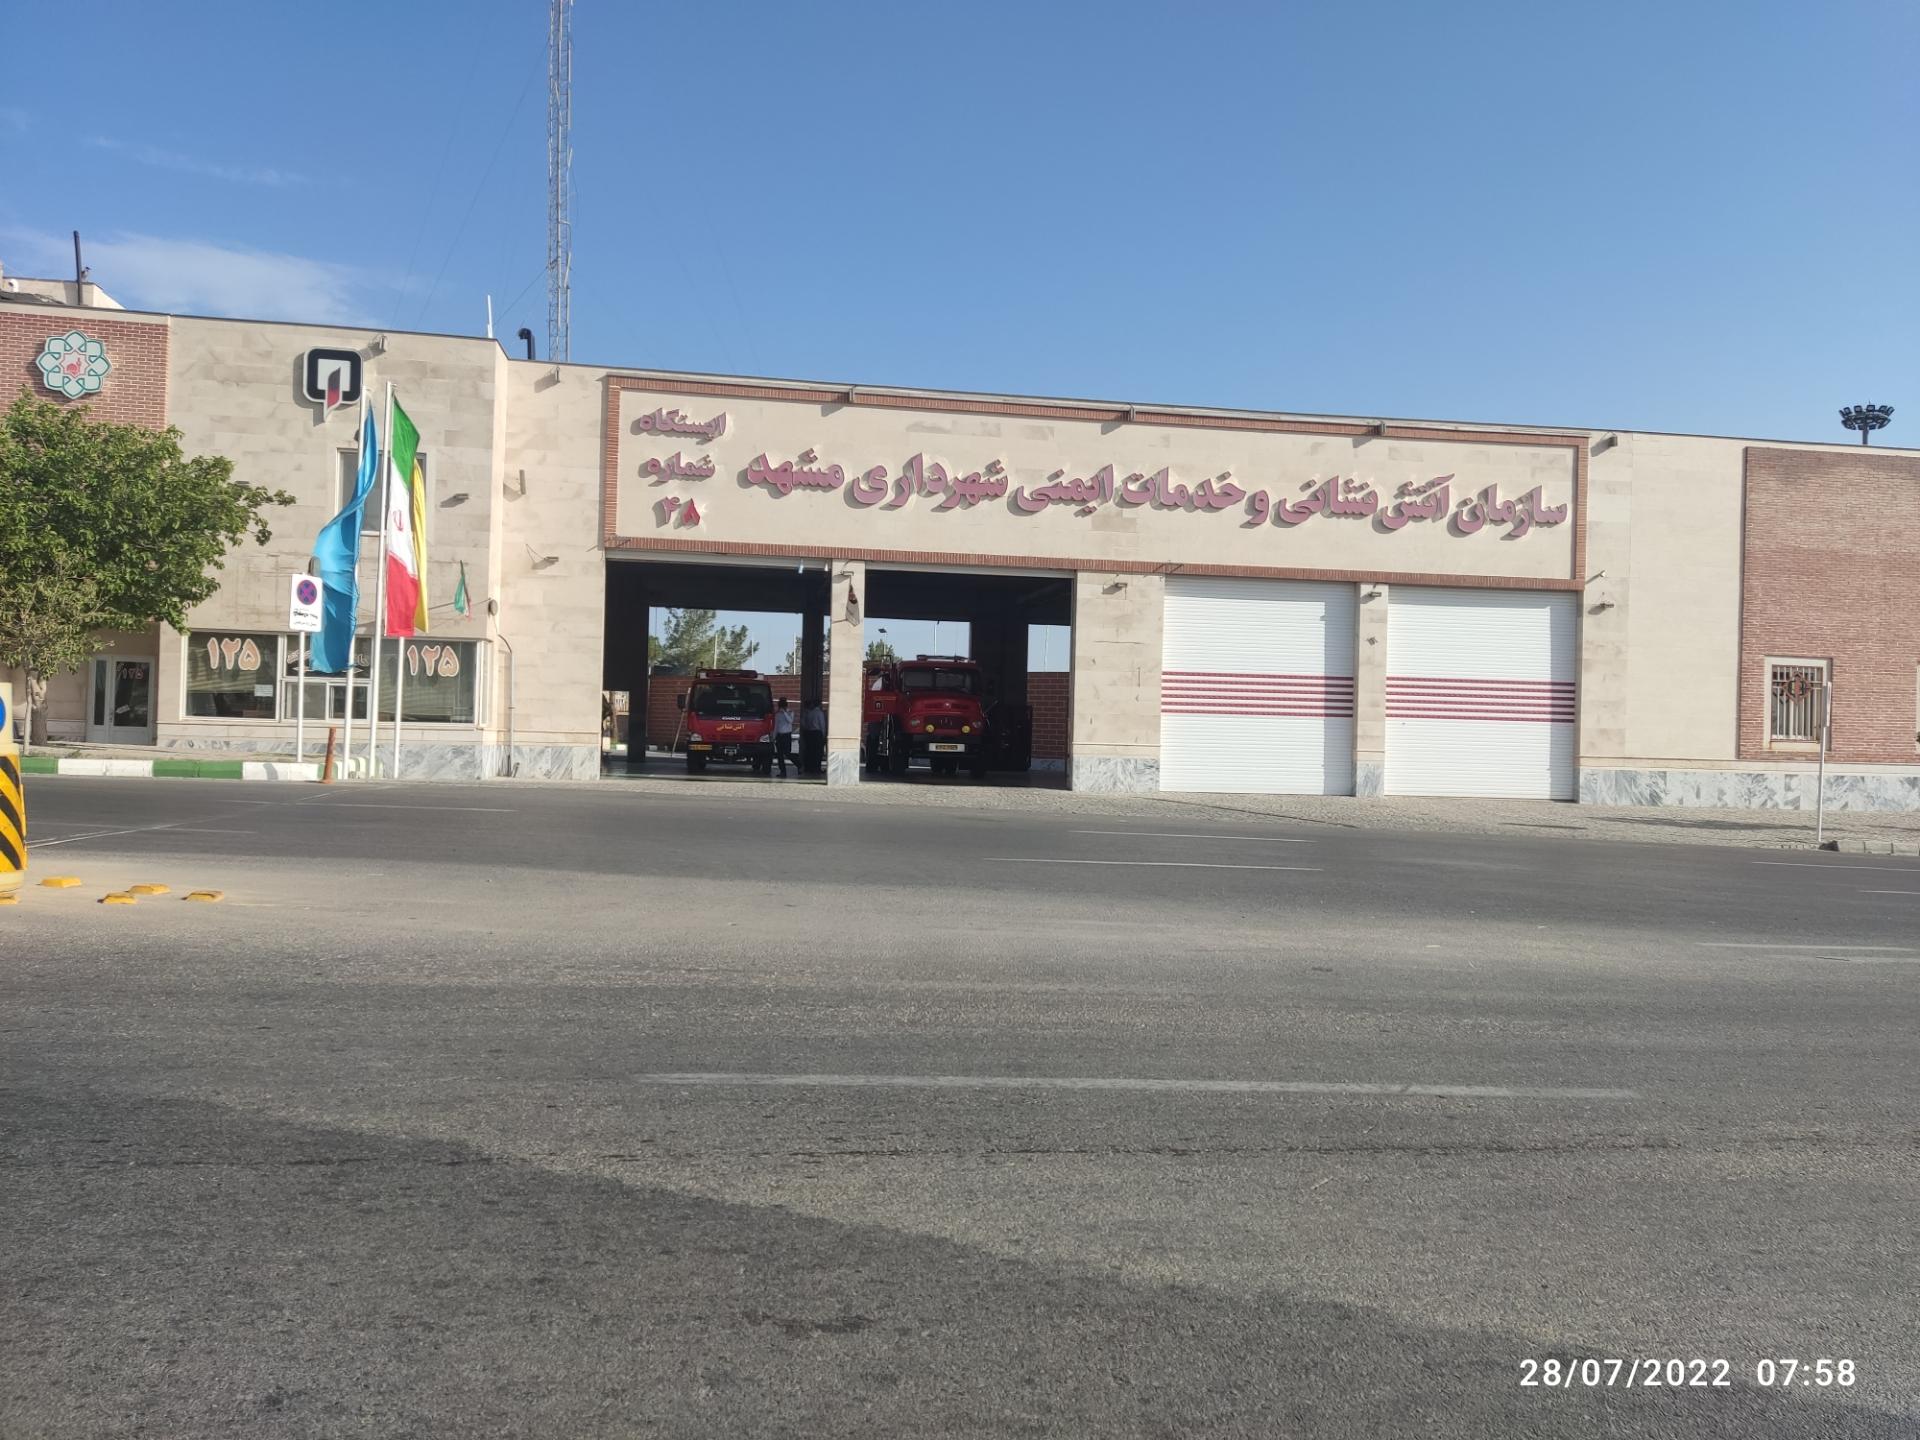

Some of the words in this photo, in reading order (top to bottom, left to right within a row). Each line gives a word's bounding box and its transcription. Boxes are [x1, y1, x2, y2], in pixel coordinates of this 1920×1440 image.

[638, 407, 727, 441] ایستگاه
[646, 451, 716, 482] شماره
[747, 448, 845, 495] مشهد
[852, 452, 1008, 509] شهرداری
[1121, 466, 1246, 508] خدمات
[1016, 463, 1114, 516] ایمنی
[1246, 489, 1270, 525] و
[1278, 475, 1379, 524] نشانی
[1382, 472, 1455, 531] آتش
[1457, 483, 1568, 538] سازمان
[661, 496, 701, 526] ۴۸
[207, 637, 261, 670] ۱۲۵
[407, 645, 459, 676] ۱۲۵
